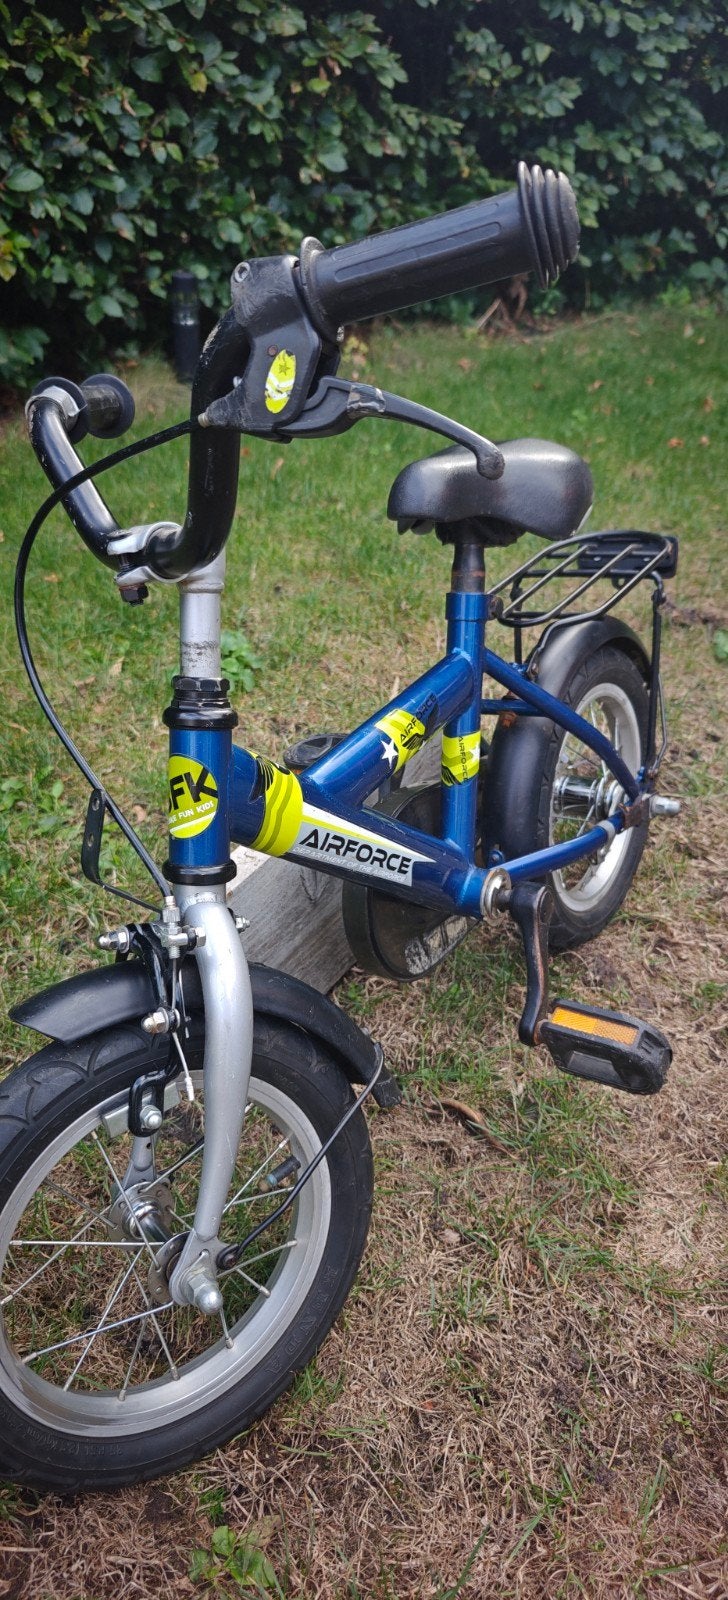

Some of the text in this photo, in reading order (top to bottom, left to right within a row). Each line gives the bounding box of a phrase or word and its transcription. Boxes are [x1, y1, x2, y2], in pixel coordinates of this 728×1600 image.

[169, 767, 218, 813] FK
[178, 809, 195, 819] FUN
[196, 800, 214, 813] KIDS
[293, 847, 347, 865] DEPARTMENT
[360, 864, 373, 873] THE
[299, 829, 412, 875] AIRFORCE
